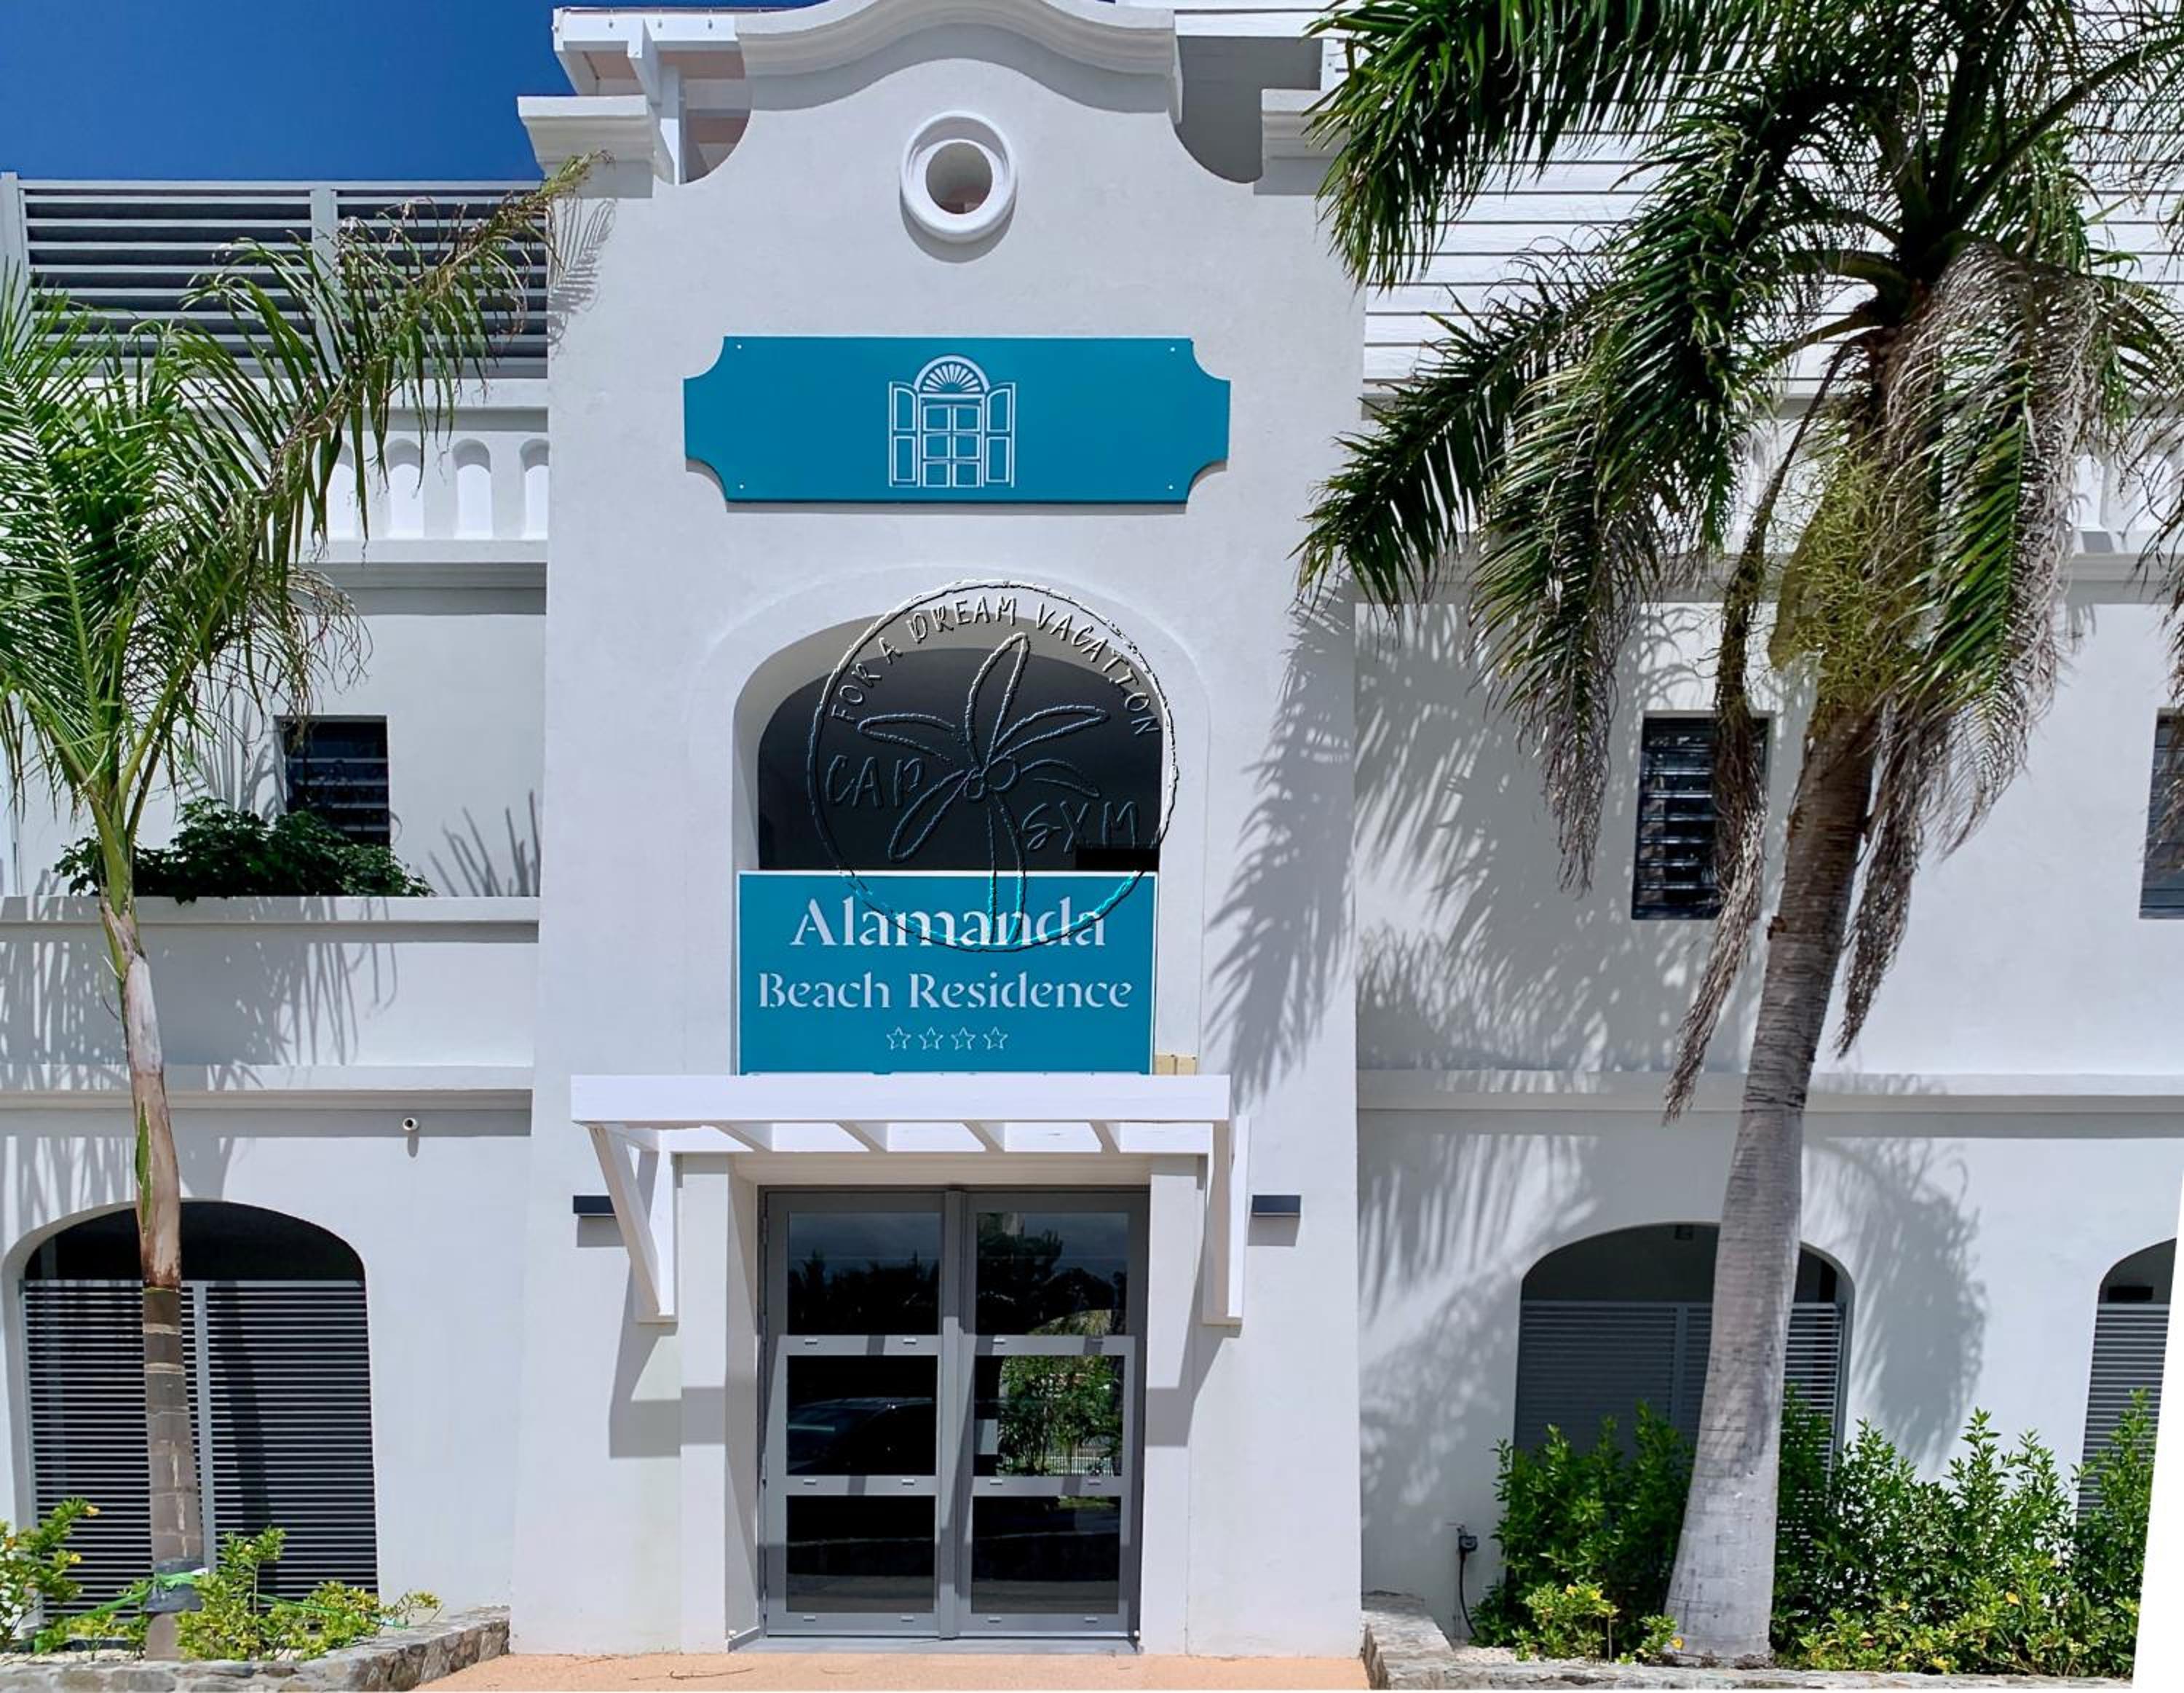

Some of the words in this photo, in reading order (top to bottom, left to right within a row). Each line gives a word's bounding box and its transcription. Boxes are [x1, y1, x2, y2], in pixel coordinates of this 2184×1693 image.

[789, 897, 1106, 946] Alamanda
[759, 972, 890, 1009] Beach
[909, 972, 1133, 1010] Residence
